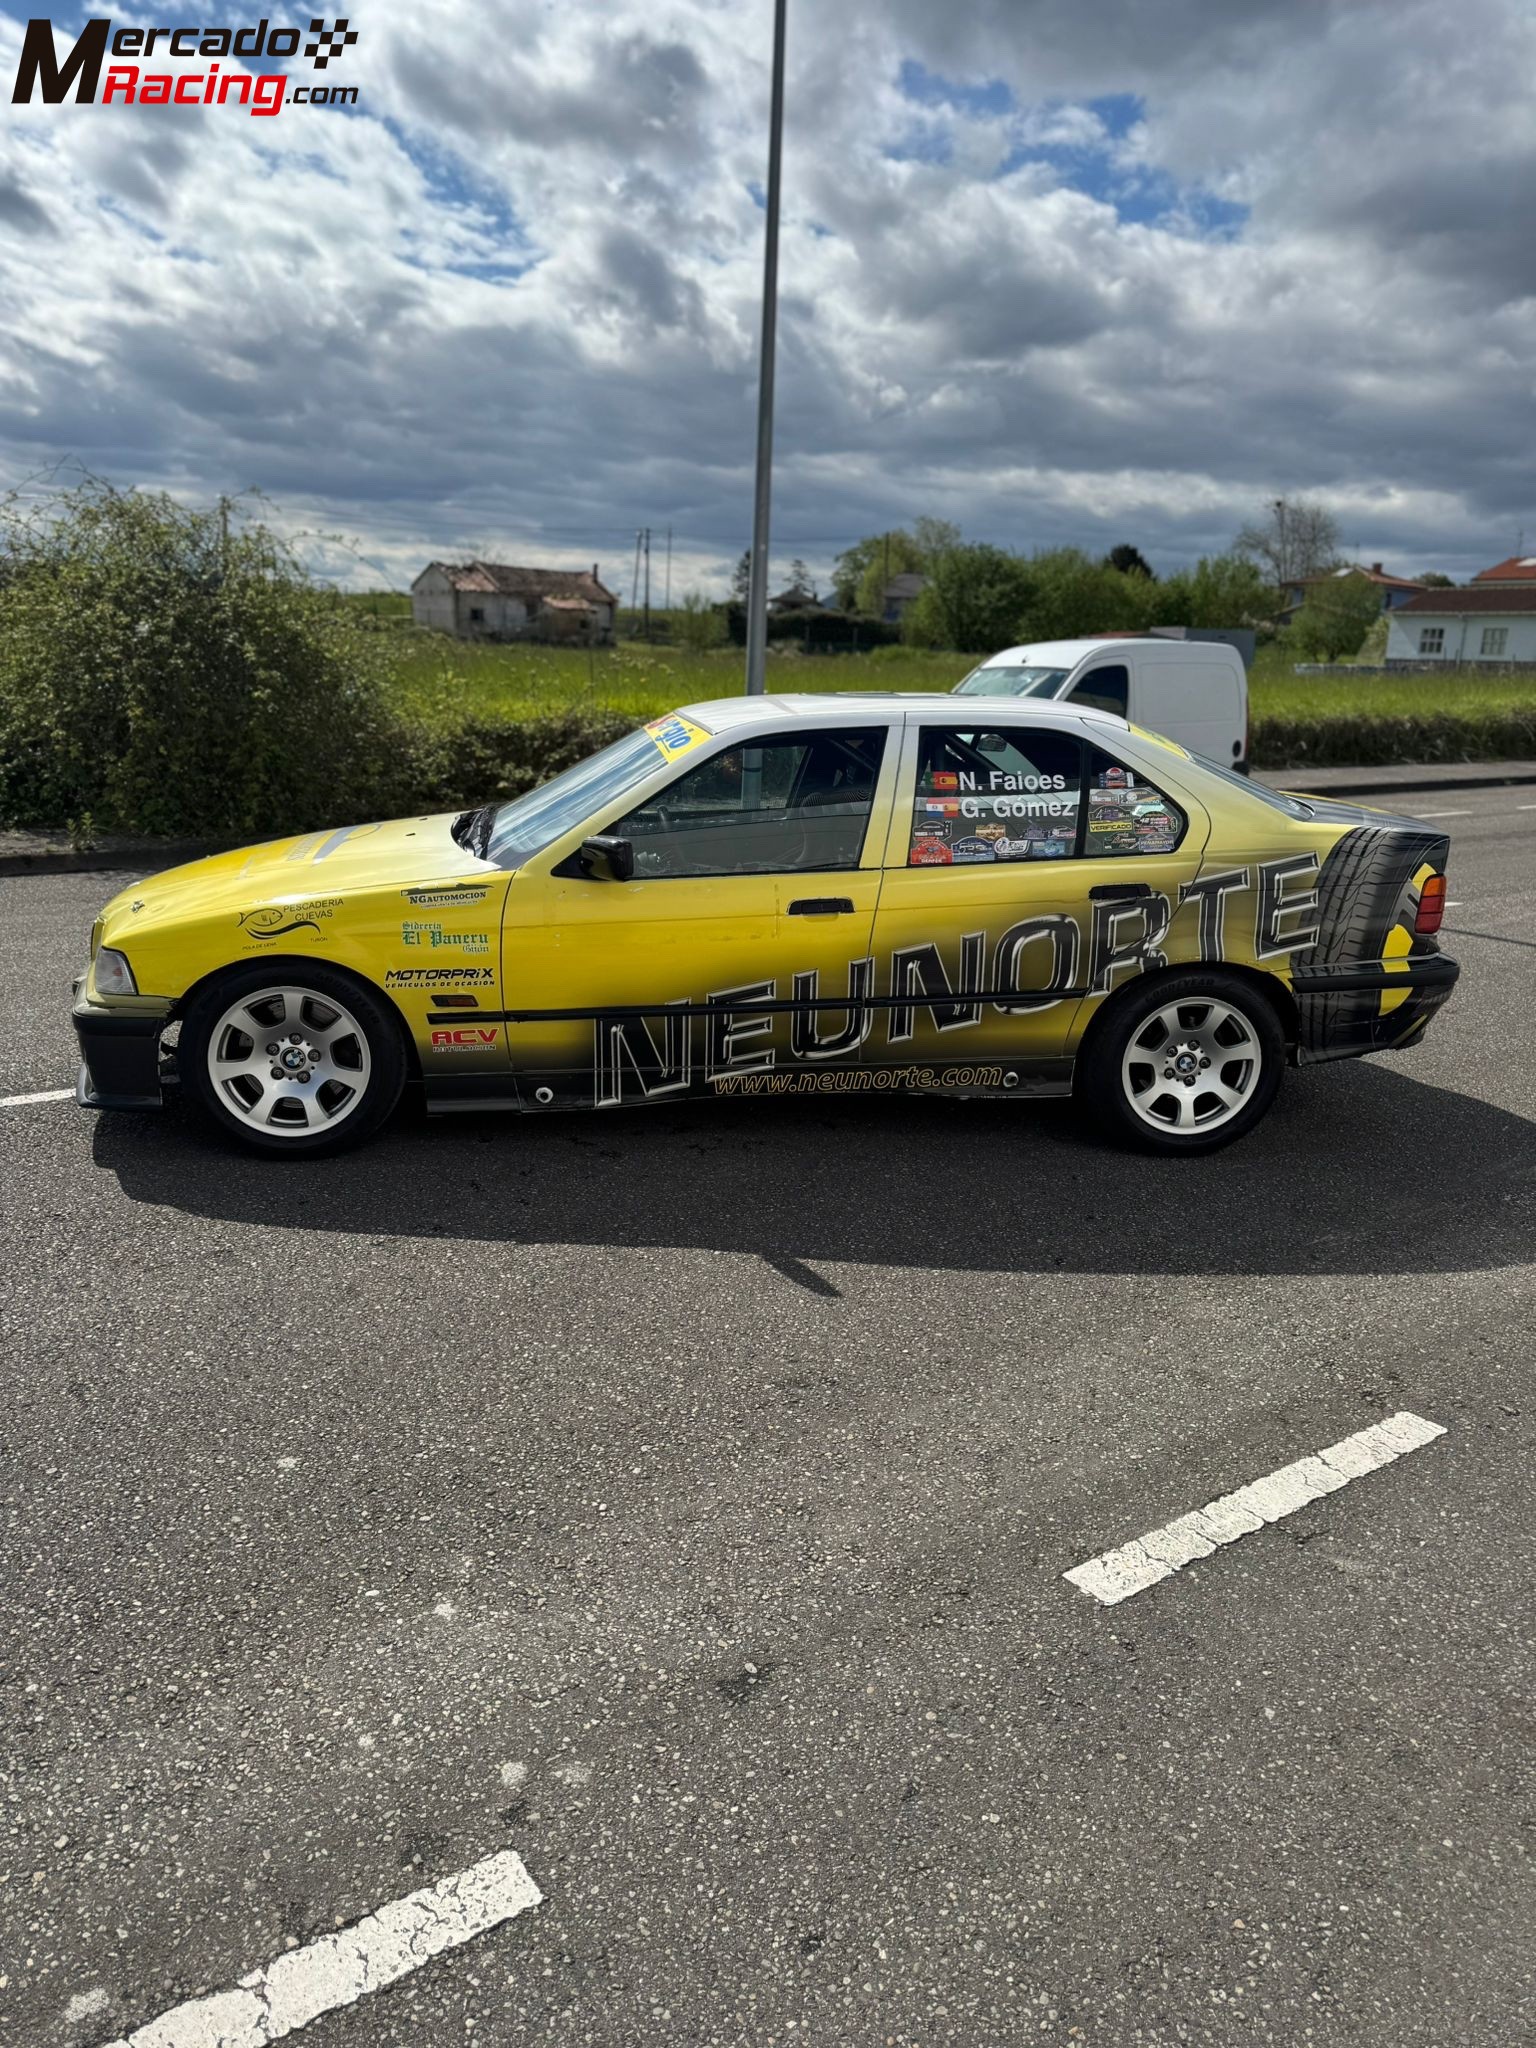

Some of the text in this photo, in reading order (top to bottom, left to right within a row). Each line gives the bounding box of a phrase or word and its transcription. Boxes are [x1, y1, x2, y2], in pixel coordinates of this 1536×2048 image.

[959, 770, 1066, 791] N. Faioes
[961, 797, 986, 819] G.
[993, 795, 1075, 818] Gómez
[1091, 823, 1132, 831] VERIFICADO
[294, 909, 333, 921] CUEVAS
[402, 931, 421, 945] El
[594, 850, 1321, 1108] NEUNORTE
[431, 1028, 499, 1046] ACV
[714, 1066, 1003, 1095] www.neunorte.com
